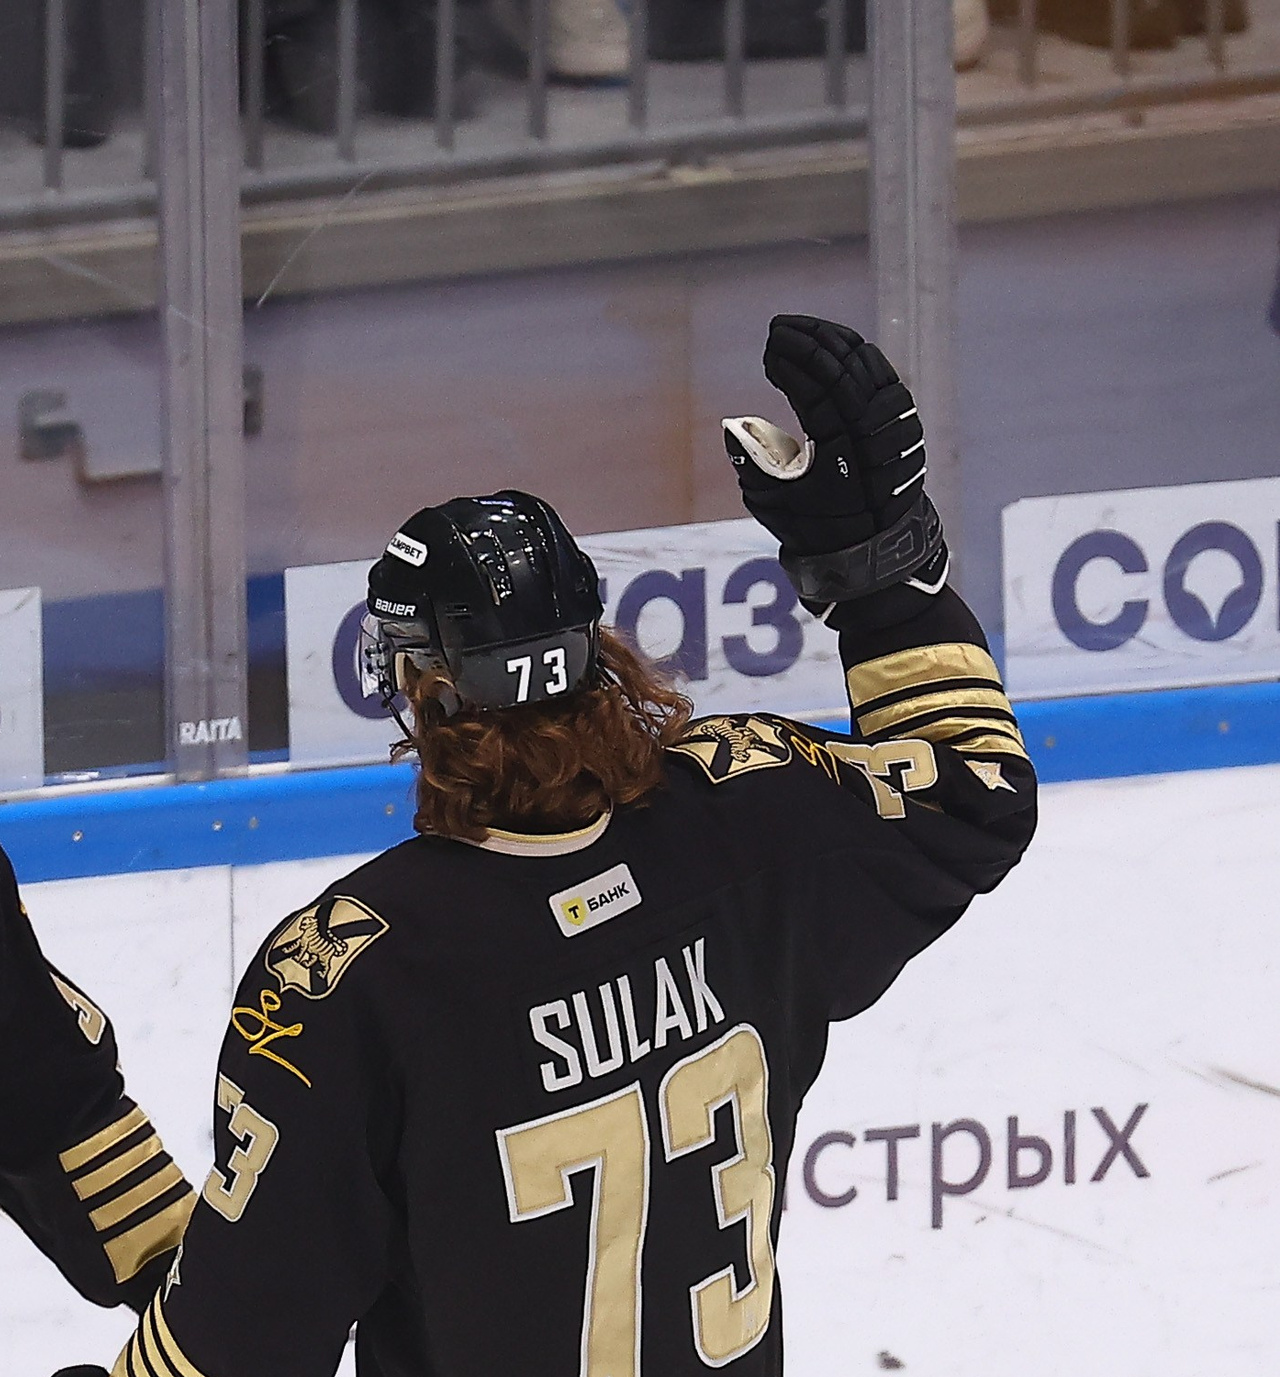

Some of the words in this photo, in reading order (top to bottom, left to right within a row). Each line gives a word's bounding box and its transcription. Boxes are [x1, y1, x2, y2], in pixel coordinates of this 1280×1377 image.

[1052, 520, 1280, 652] со
[507, 647, 568, 702] 73
[179, 716, 241, 745] RAITA
[587, 882, 630, 912] БАНК
[529, 937, 725, 1092] SULAK
[783, 1103, 1151, 1229] стрых
